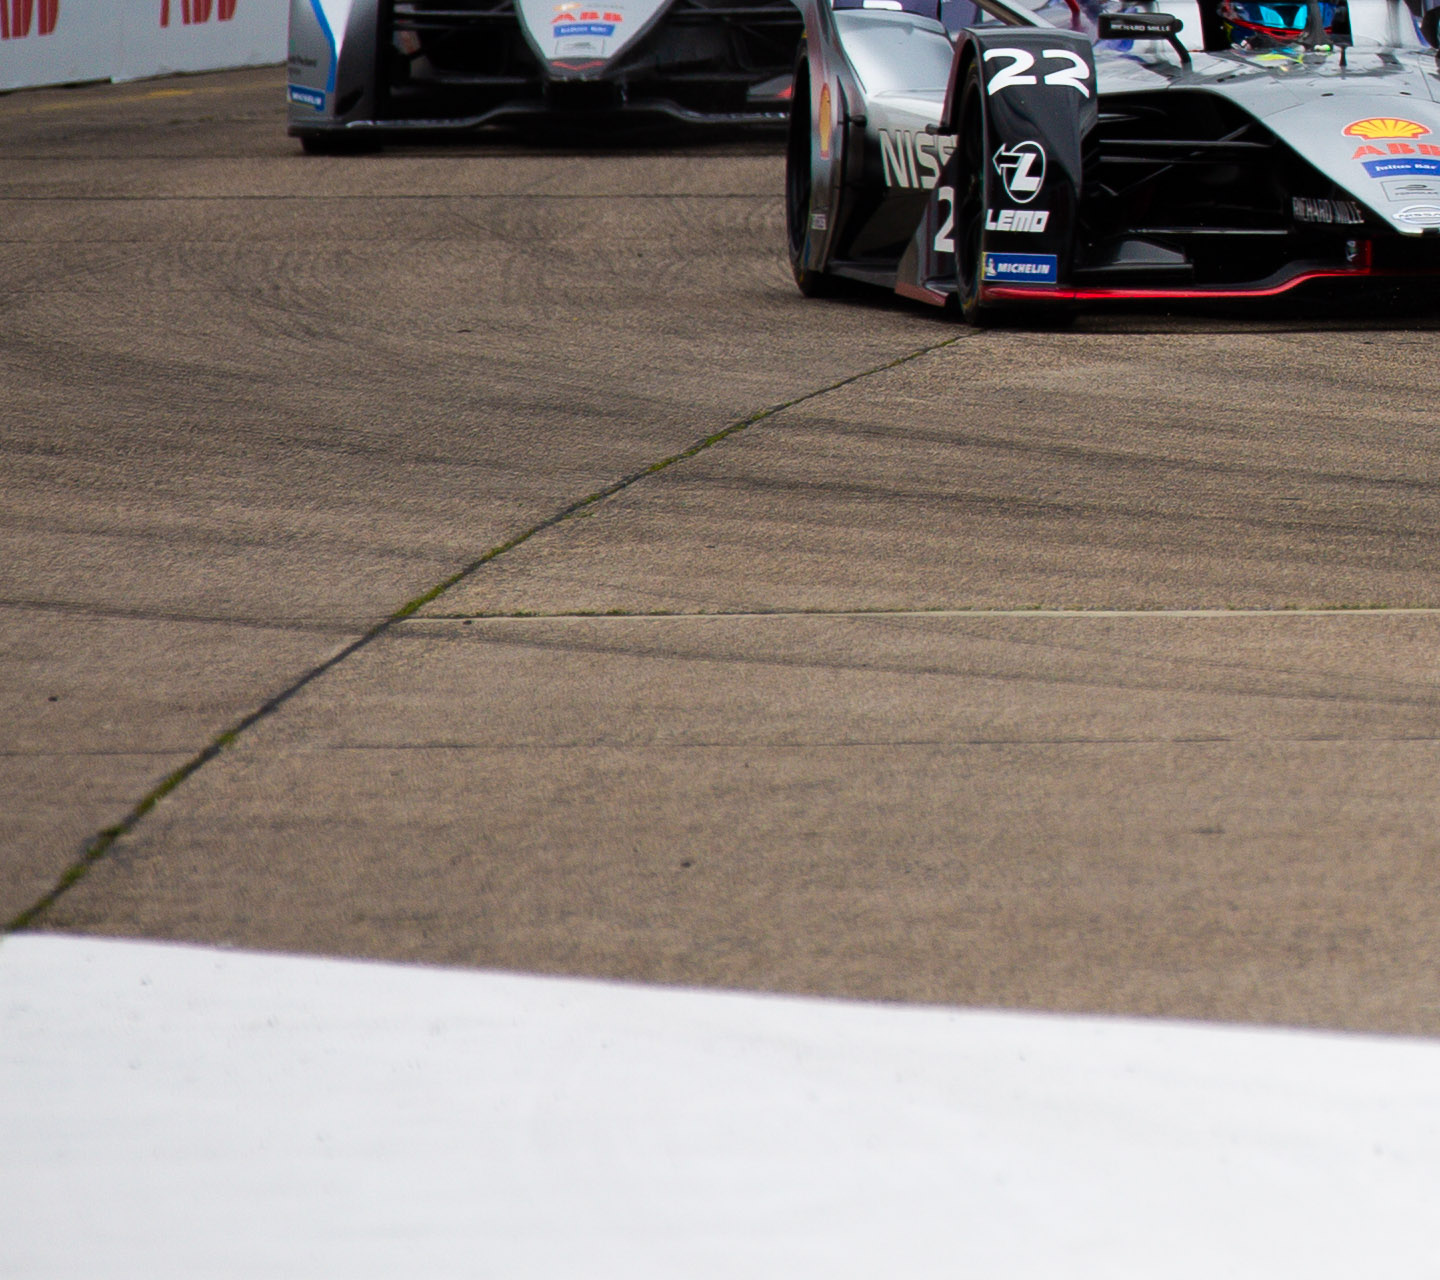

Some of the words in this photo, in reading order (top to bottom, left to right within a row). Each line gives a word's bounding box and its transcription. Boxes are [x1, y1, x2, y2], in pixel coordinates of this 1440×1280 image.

[551, 12, 623, 23] ABB
[1110, 23, 1145, 32] RICHARD
[1147, 23, 1170, 32] MILLE
[984, 48, 1090, 99] 22
[985, 208, 1049, 232] LEMO
[997, 262, 1050, 275] MICHELIN
